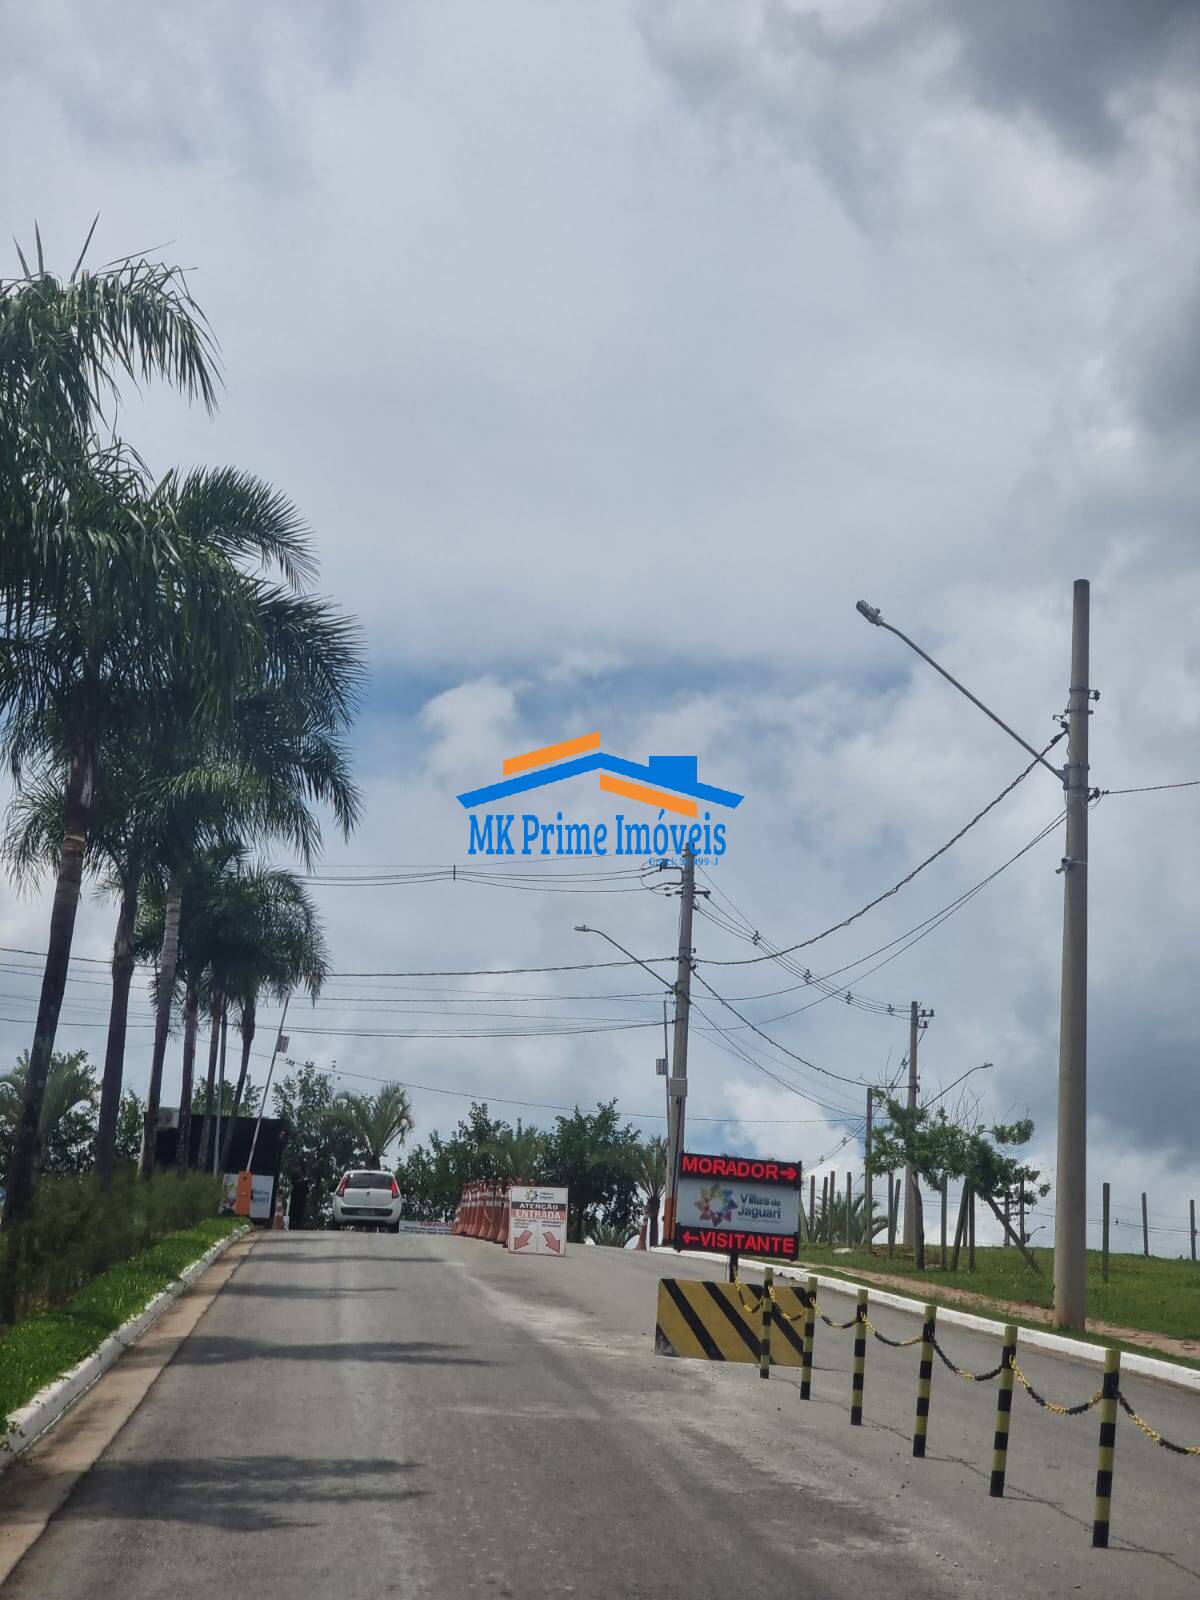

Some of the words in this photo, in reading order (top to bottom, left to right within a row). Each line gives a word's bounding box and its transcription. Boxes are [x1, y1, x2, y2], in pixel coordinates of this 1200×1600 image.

[682, 1156, 779, 1179] MORADOR
[516, 1210, 561, 1219] ENTRADA
[737, 1207, 781, 1219] Jaguari
[700, 1231, 795, 1254] VISITANTE
